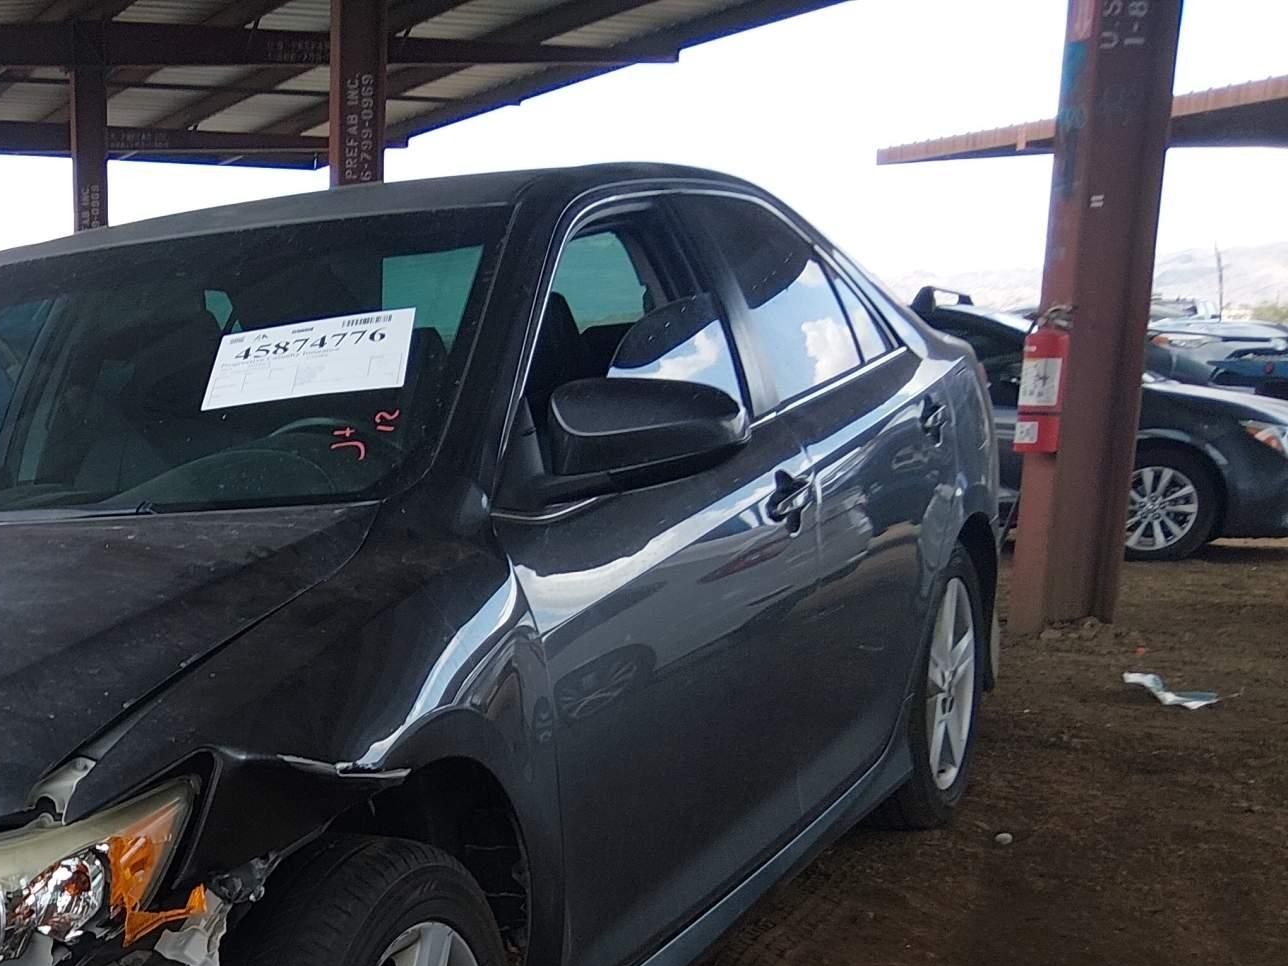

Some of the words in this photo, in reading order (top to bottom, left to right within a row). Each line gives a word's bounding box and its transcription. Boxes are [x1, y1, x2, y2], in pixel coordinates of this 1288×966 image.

[346, 72, 361, 106] INC.
[345, 114, 359, 180] PREFAB
[234, 327, 387, 360] 45874776
